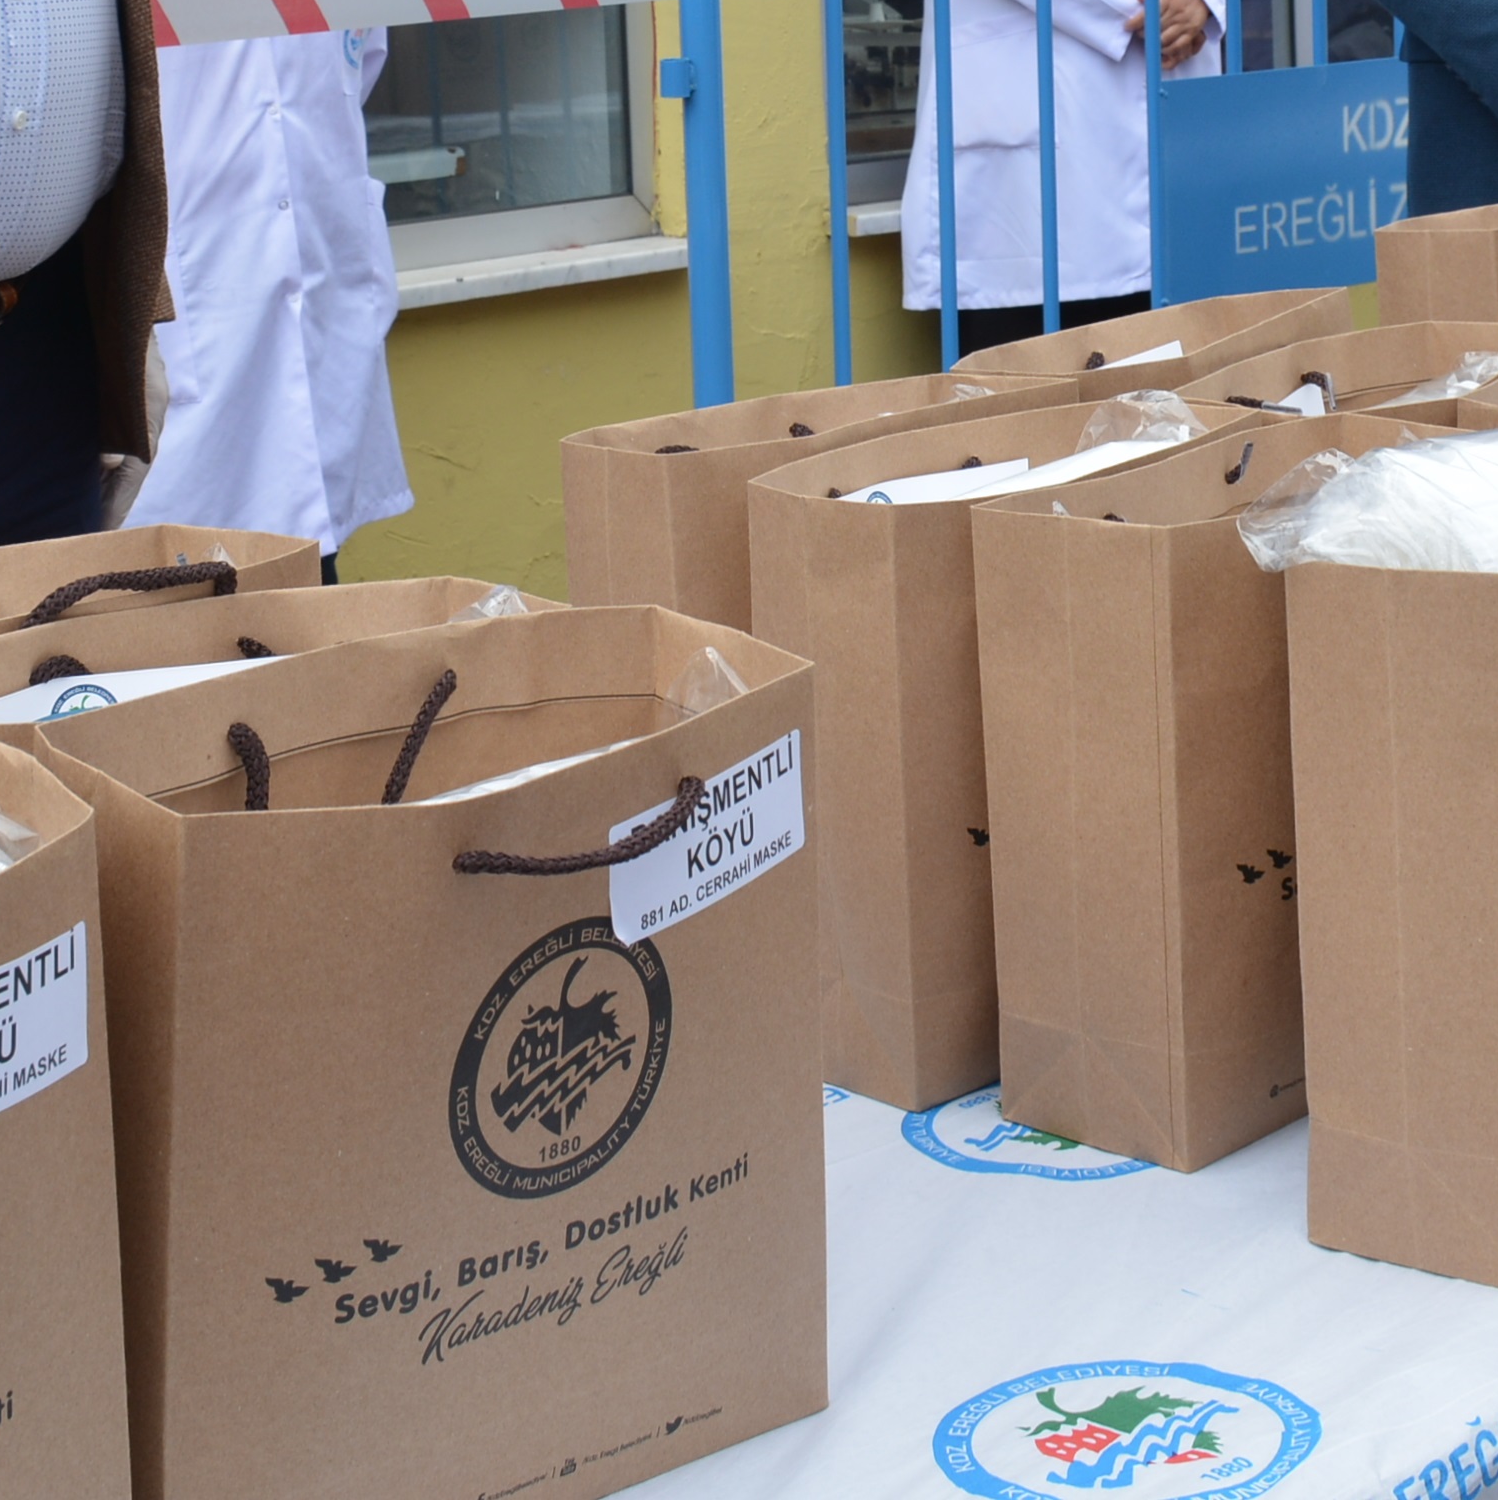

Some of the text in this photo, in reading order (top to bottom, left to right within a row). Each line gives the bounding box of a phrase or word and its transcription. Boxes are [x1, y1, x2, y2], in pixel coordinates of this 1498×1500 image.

[1234, 178, 1377, 255] EREĞLİ
[640, 830, 793, 931] 881 AD. CERRAHİ MASKE
[686, 806, 755, 880] KÖYÜ
[473, 991, 509, 1041] KDZ.
[508, 927, 574, 988] EREĞLİ
[12, 1043, 68, 1092] MASKE
[456, 1016, 666, 1191] KDZ. EREĞLİ MUNICIPALITY TÜRKİYE
[538, 1134, 582, 1164] 1880
[1018, 1157, 1144, 1179] ELEDİYESİ
[334, 1151, 750, 1325] Sevgi, Barış, Dostluk Kenti
[417, 1225, 688, 1366] Karadeniz Ereğli
[944, 1362, 1170, 1475] KDZ. EREĞLİ BELEDİYESİ
[1235, 1381, 1312, 1436] TÜRKİYE
[1200, 1455, 1254, 1483] 1880
